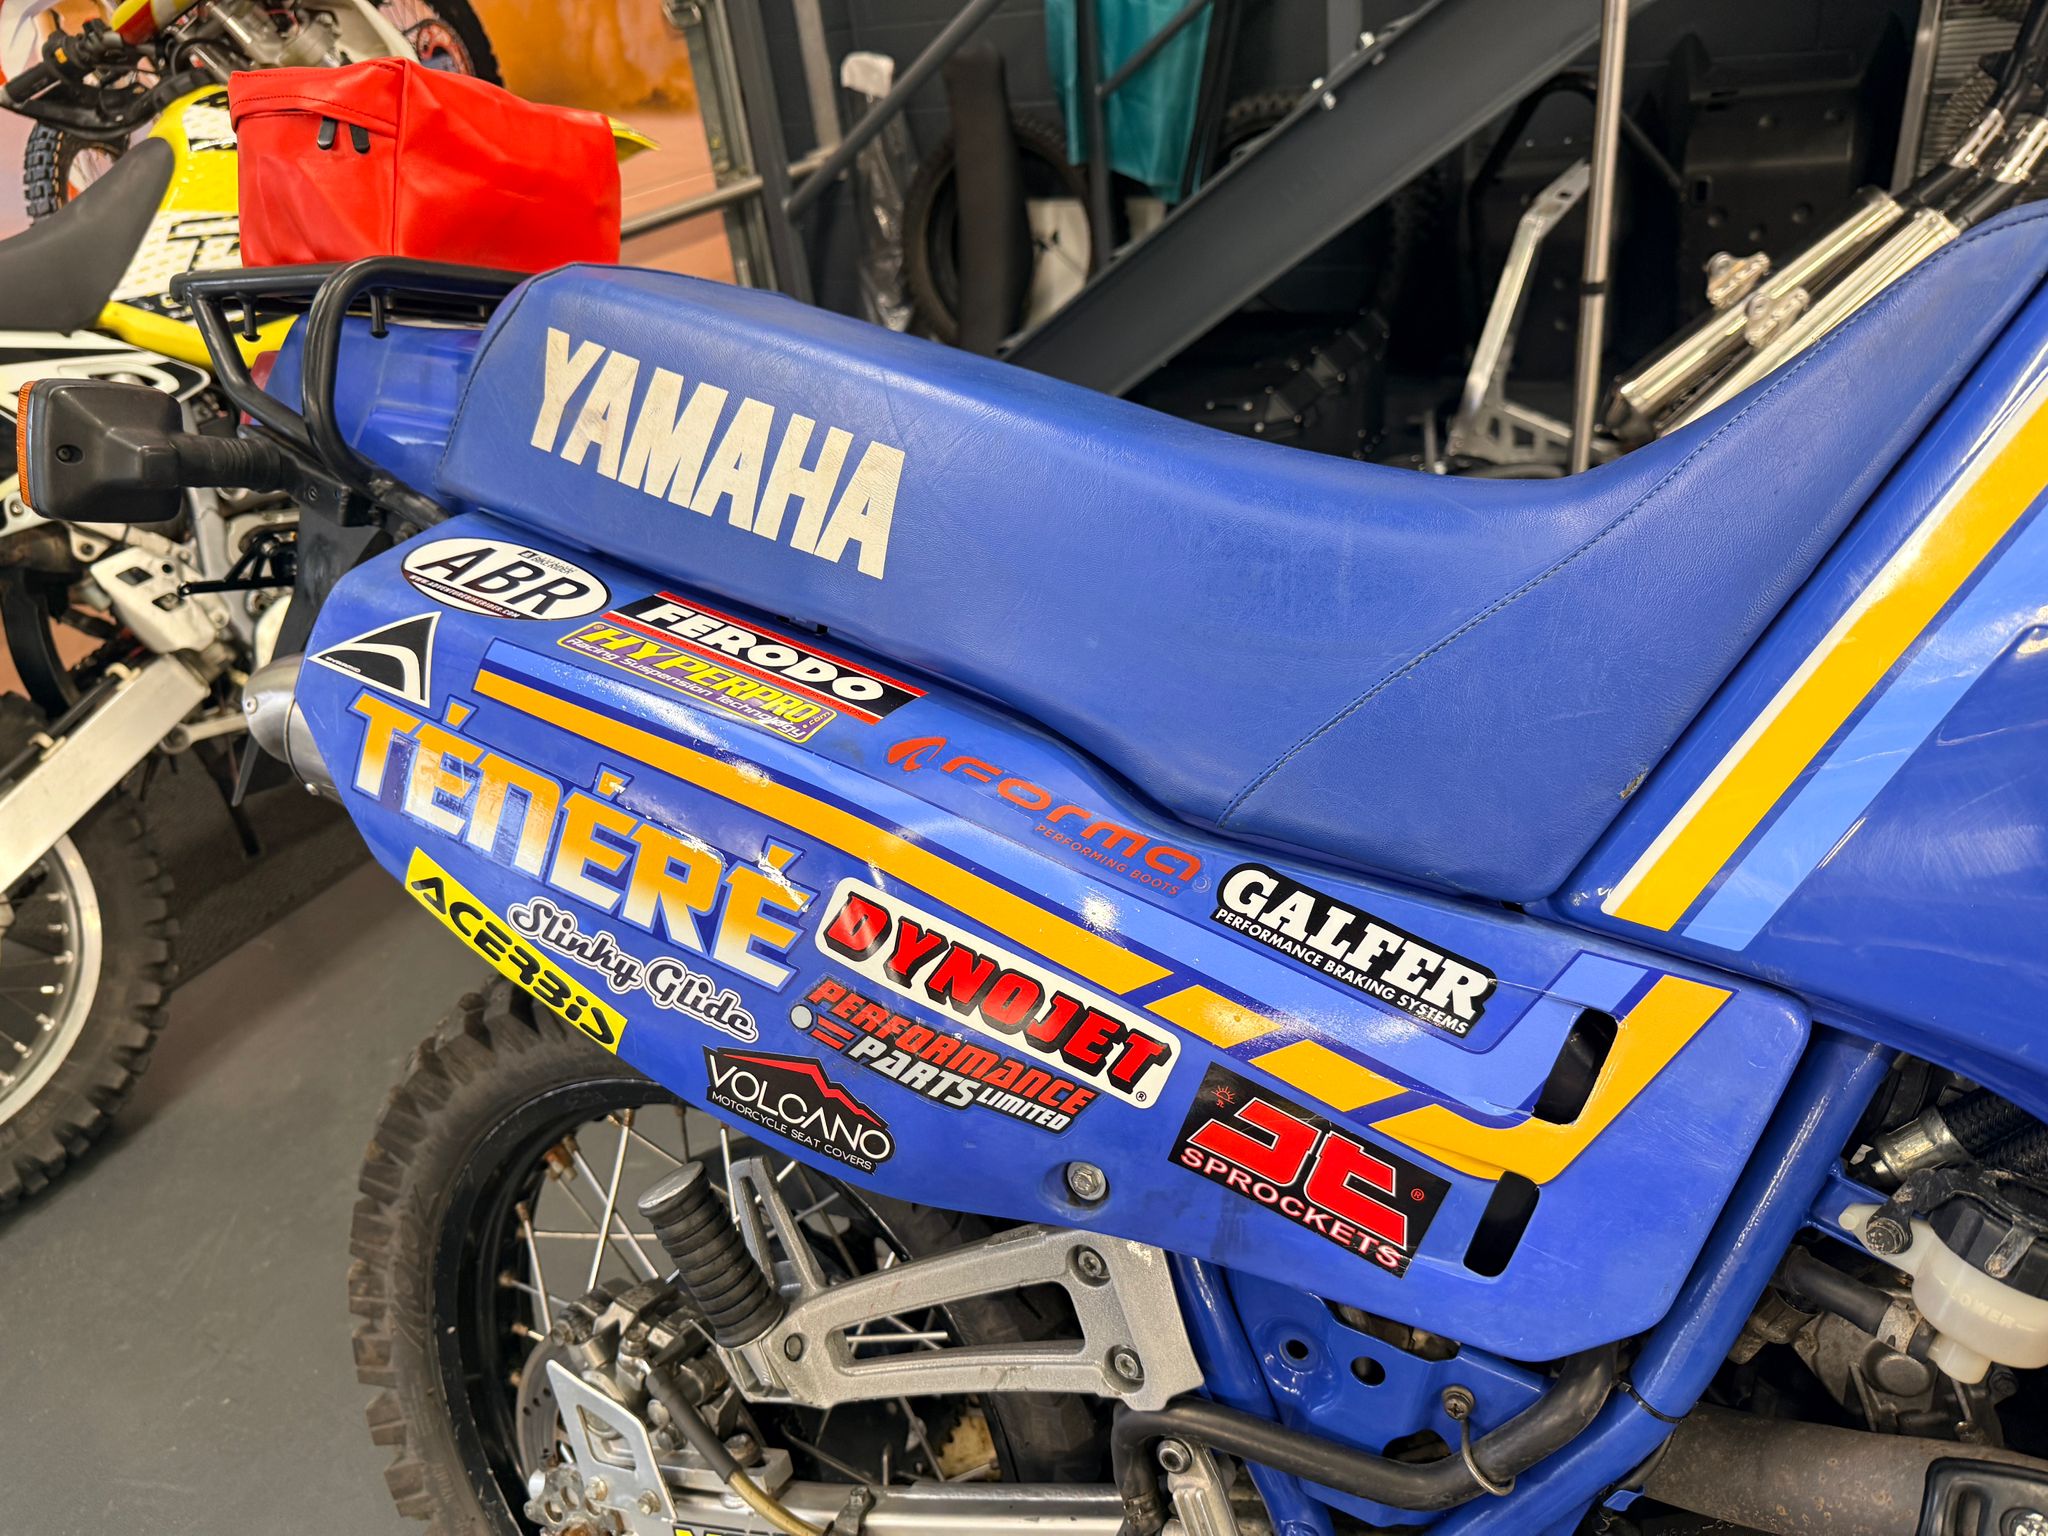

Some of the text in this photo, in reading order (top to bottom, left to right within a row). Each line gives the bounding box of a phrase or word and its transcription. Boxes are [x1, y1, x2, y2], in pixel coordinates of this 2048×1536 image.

[531, 327, 905, 580] YAMAHA
[414, 547, 590, 615] ABR
[566, 638, 806, 738] Racing Suspension Technology
[577, 628, 821, 723] HYPERPRO
[636, 603, 884, 700] FERODO
[350, 690, 820, 990] TÉNÉRÉ
[1035, 823, 1180, 895] PERFORMING BOOTS
[510, 900, 757, 1041] Slinky Glide
[823, 891, 1172, 1094] DYNOJET
[1216, 908, 1469, 1034] PERFORMANCE BRAKING SYSTEMS
[1223, 869, 1488, 1019] GALFER
[809, 980, 1098, 1115] PERFORMANCE
[848, 1035, 1072, 1132] PARTS LIMITED
[710, 1054, 891, 1159] VOLCANO
[712, 1091, 872, 1170] MOTORCYCLE SEAT COVERS
[1179, 1147, 1400, 1268] SPROCKETS
